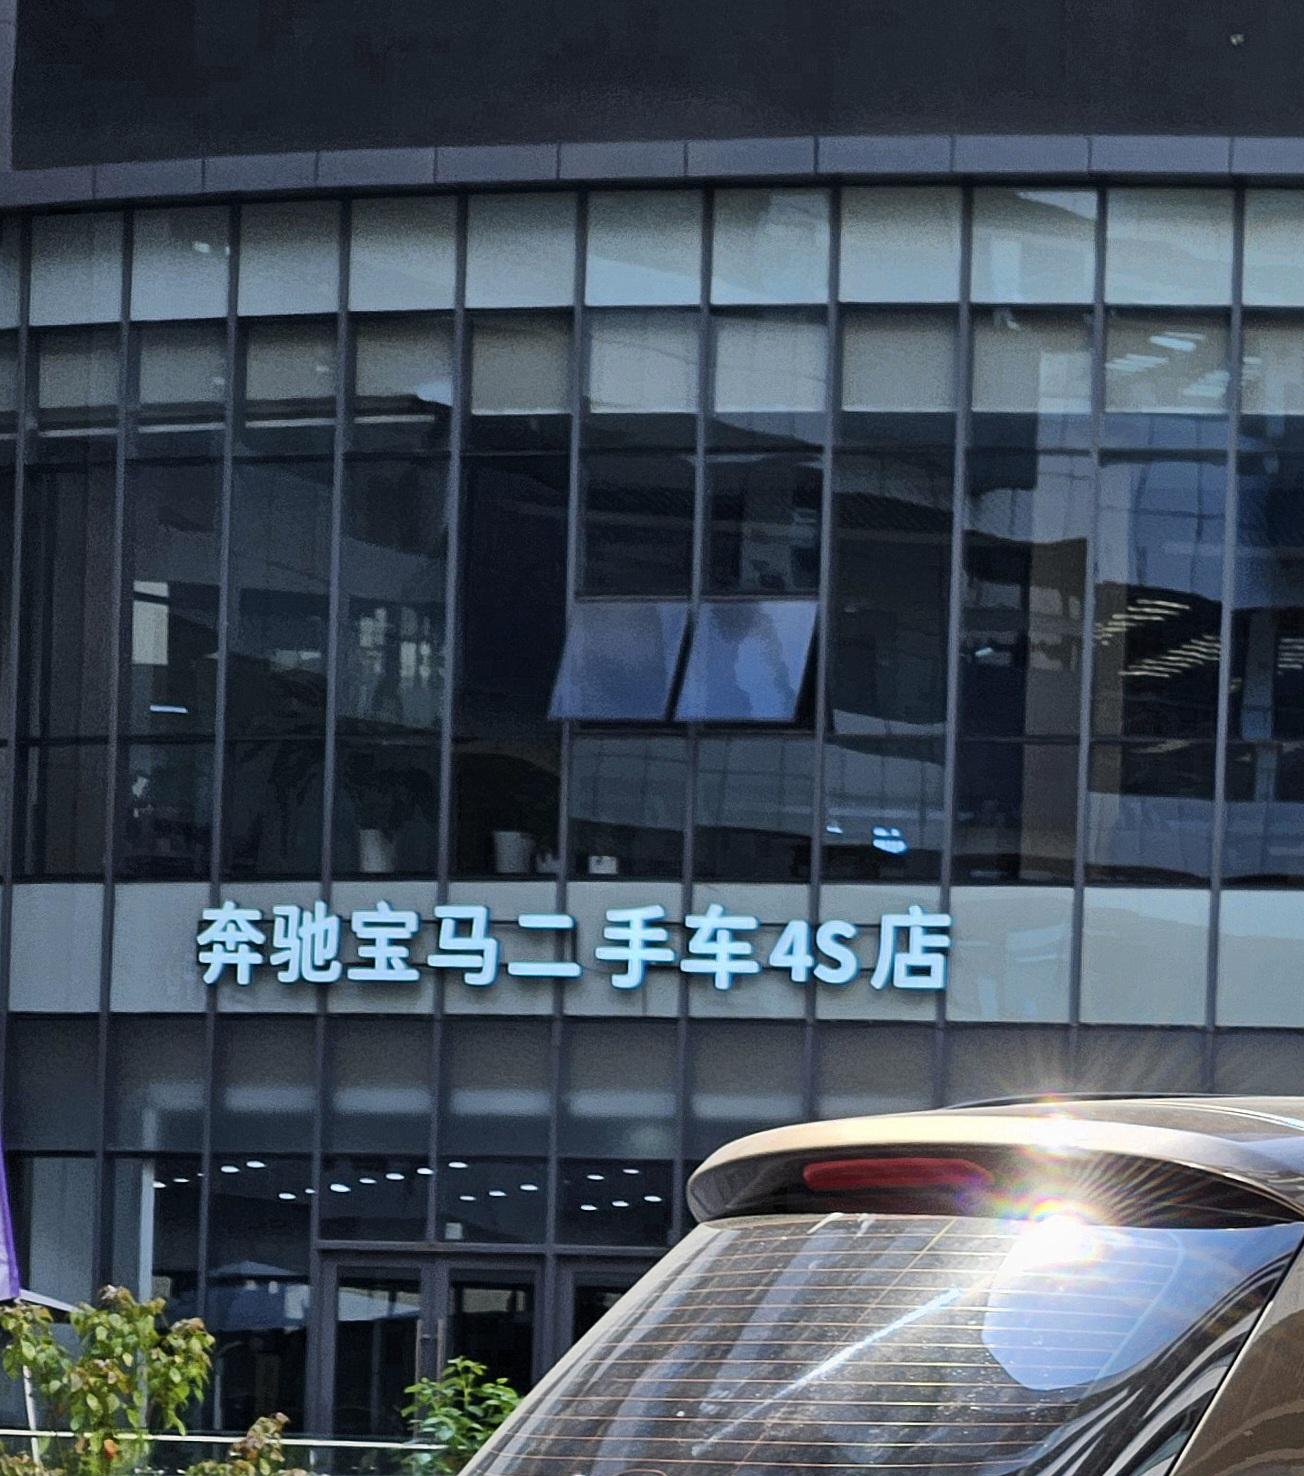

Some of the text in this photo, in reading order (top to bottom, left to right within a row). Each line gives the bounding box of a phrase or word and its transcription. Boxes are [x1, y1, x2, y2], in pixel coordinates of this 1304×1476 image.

[196, 900, 952, 991] 奔驰宝马二手车4S店
